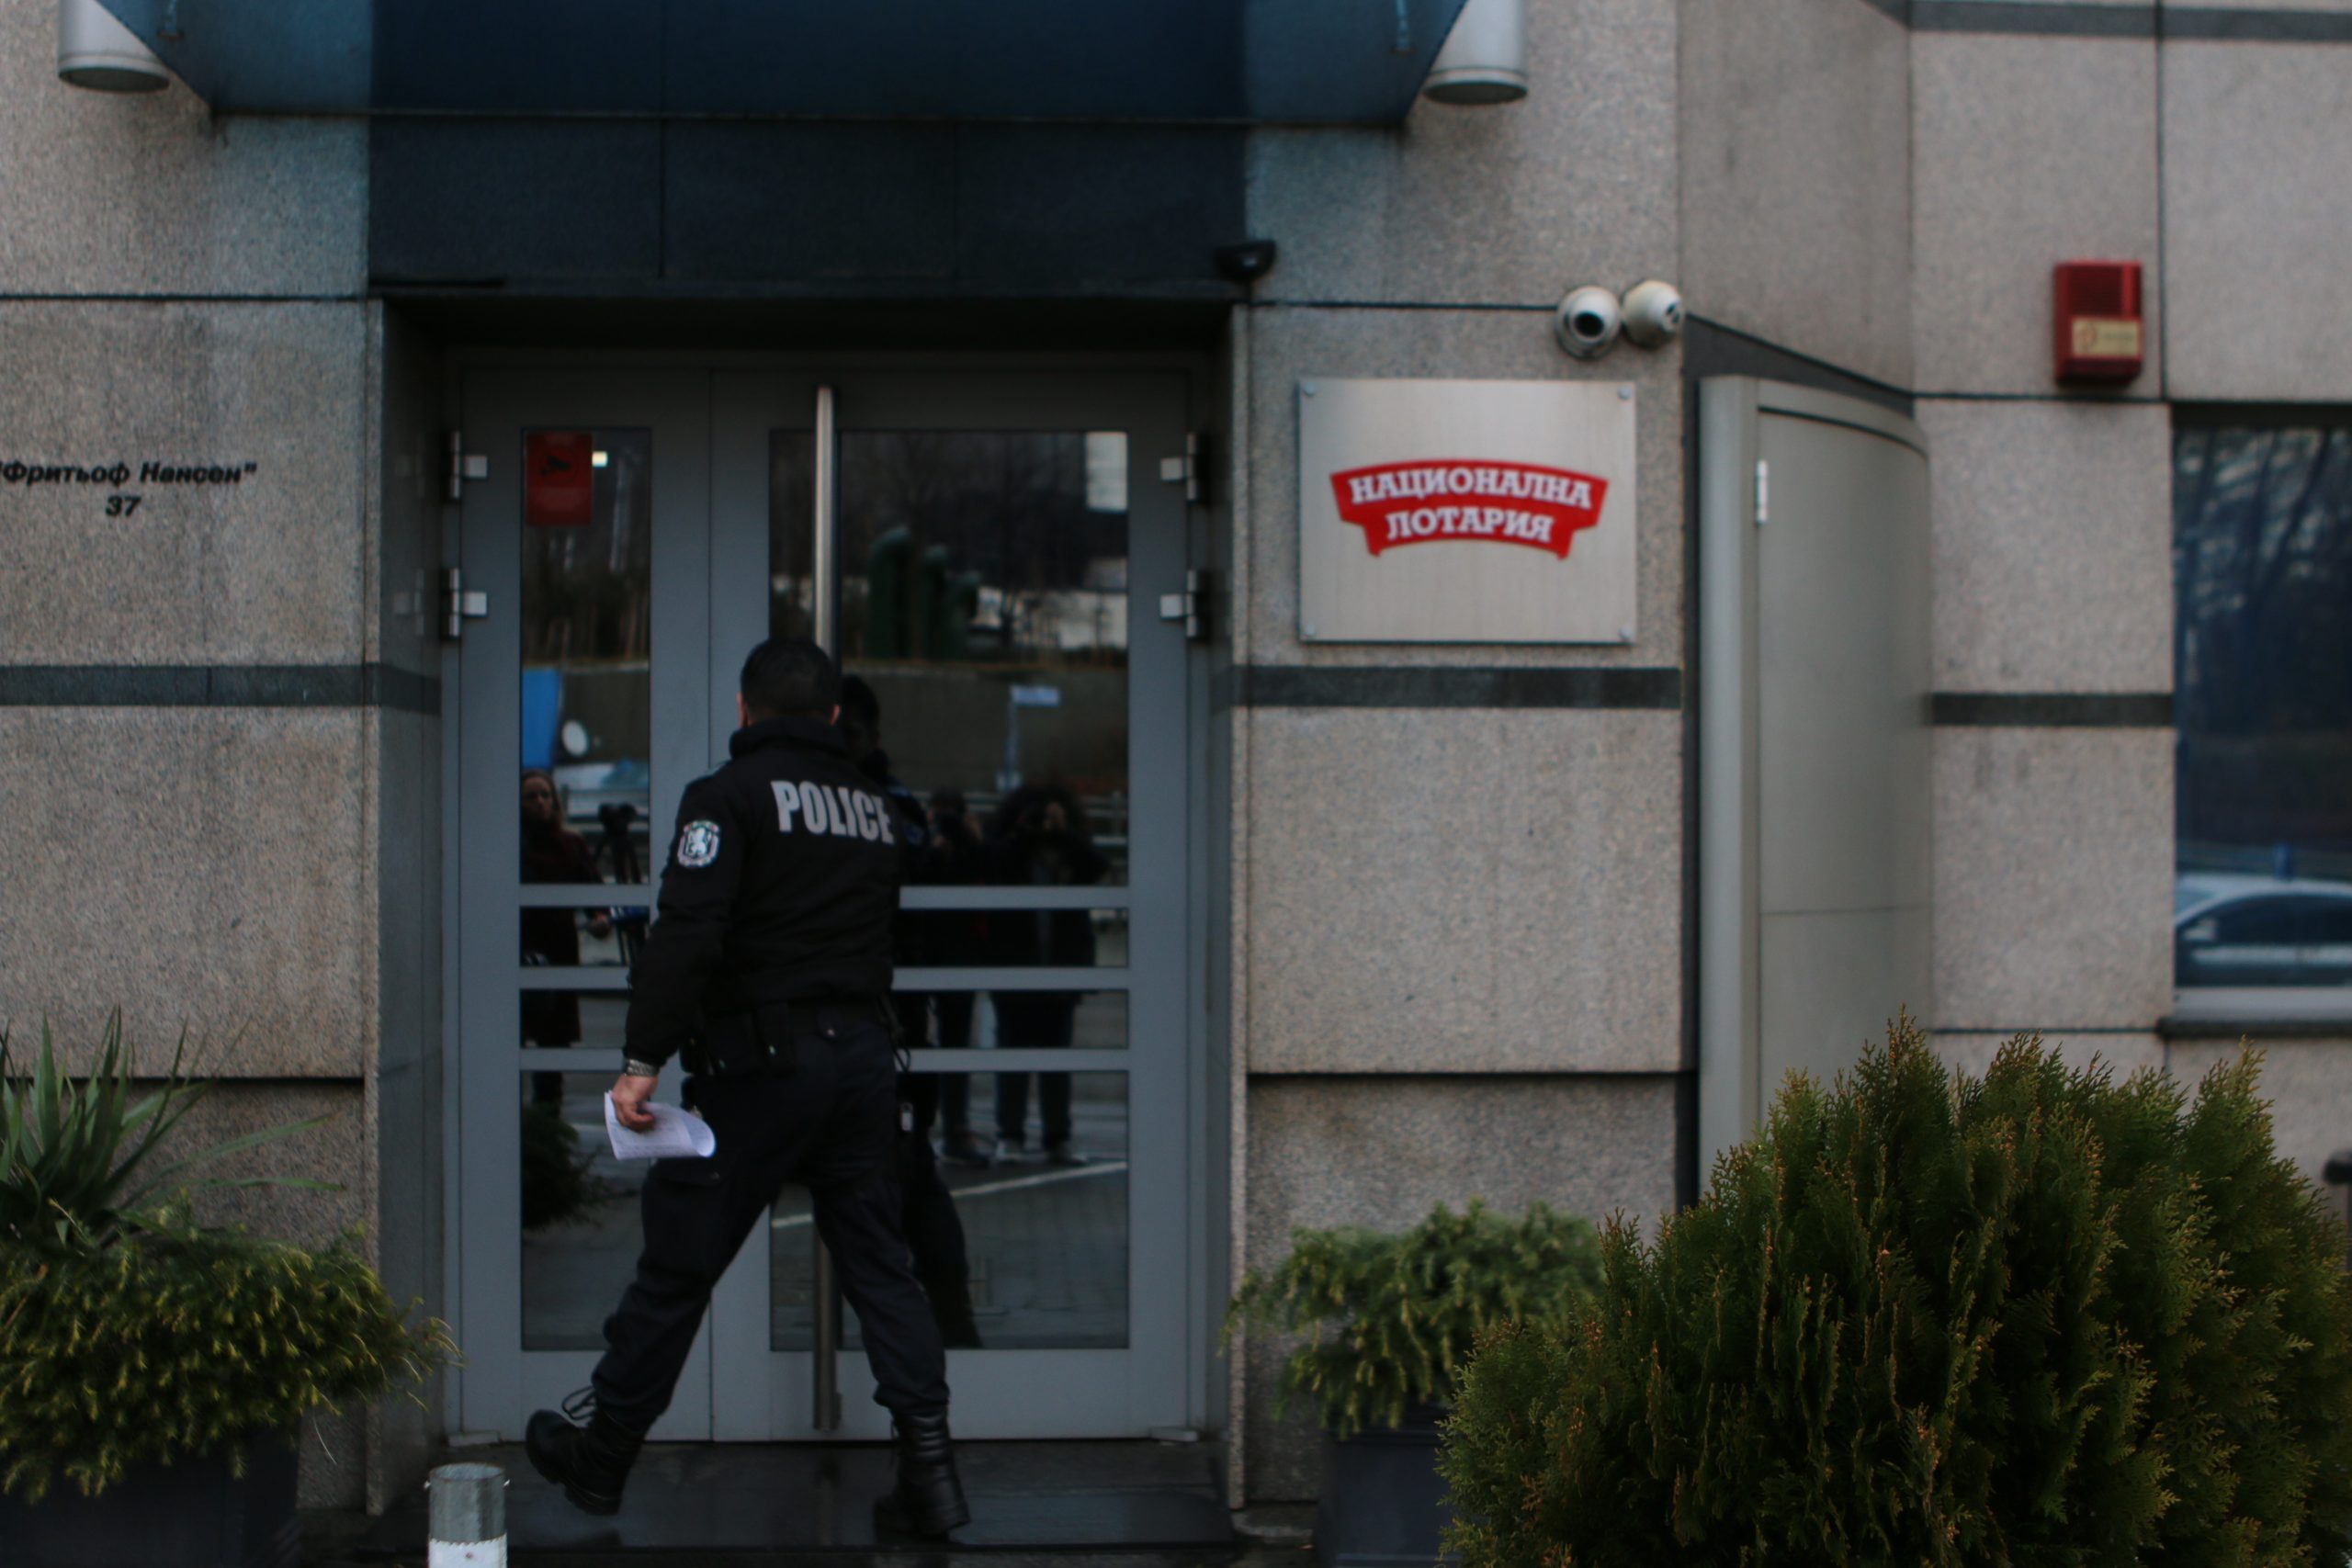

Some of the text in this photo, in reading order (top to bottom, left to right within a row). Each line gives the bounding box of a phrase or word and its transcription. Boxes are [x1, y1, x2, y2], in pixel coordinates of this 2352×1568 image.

[105, 494, 141, 517] 37
[1348, 466, 1593, 510] НАЦИОНАЛНА
[1385, 505, 1555, 543] ЛОТАРИЯ
[770, 780, 895, 845] POLICE
